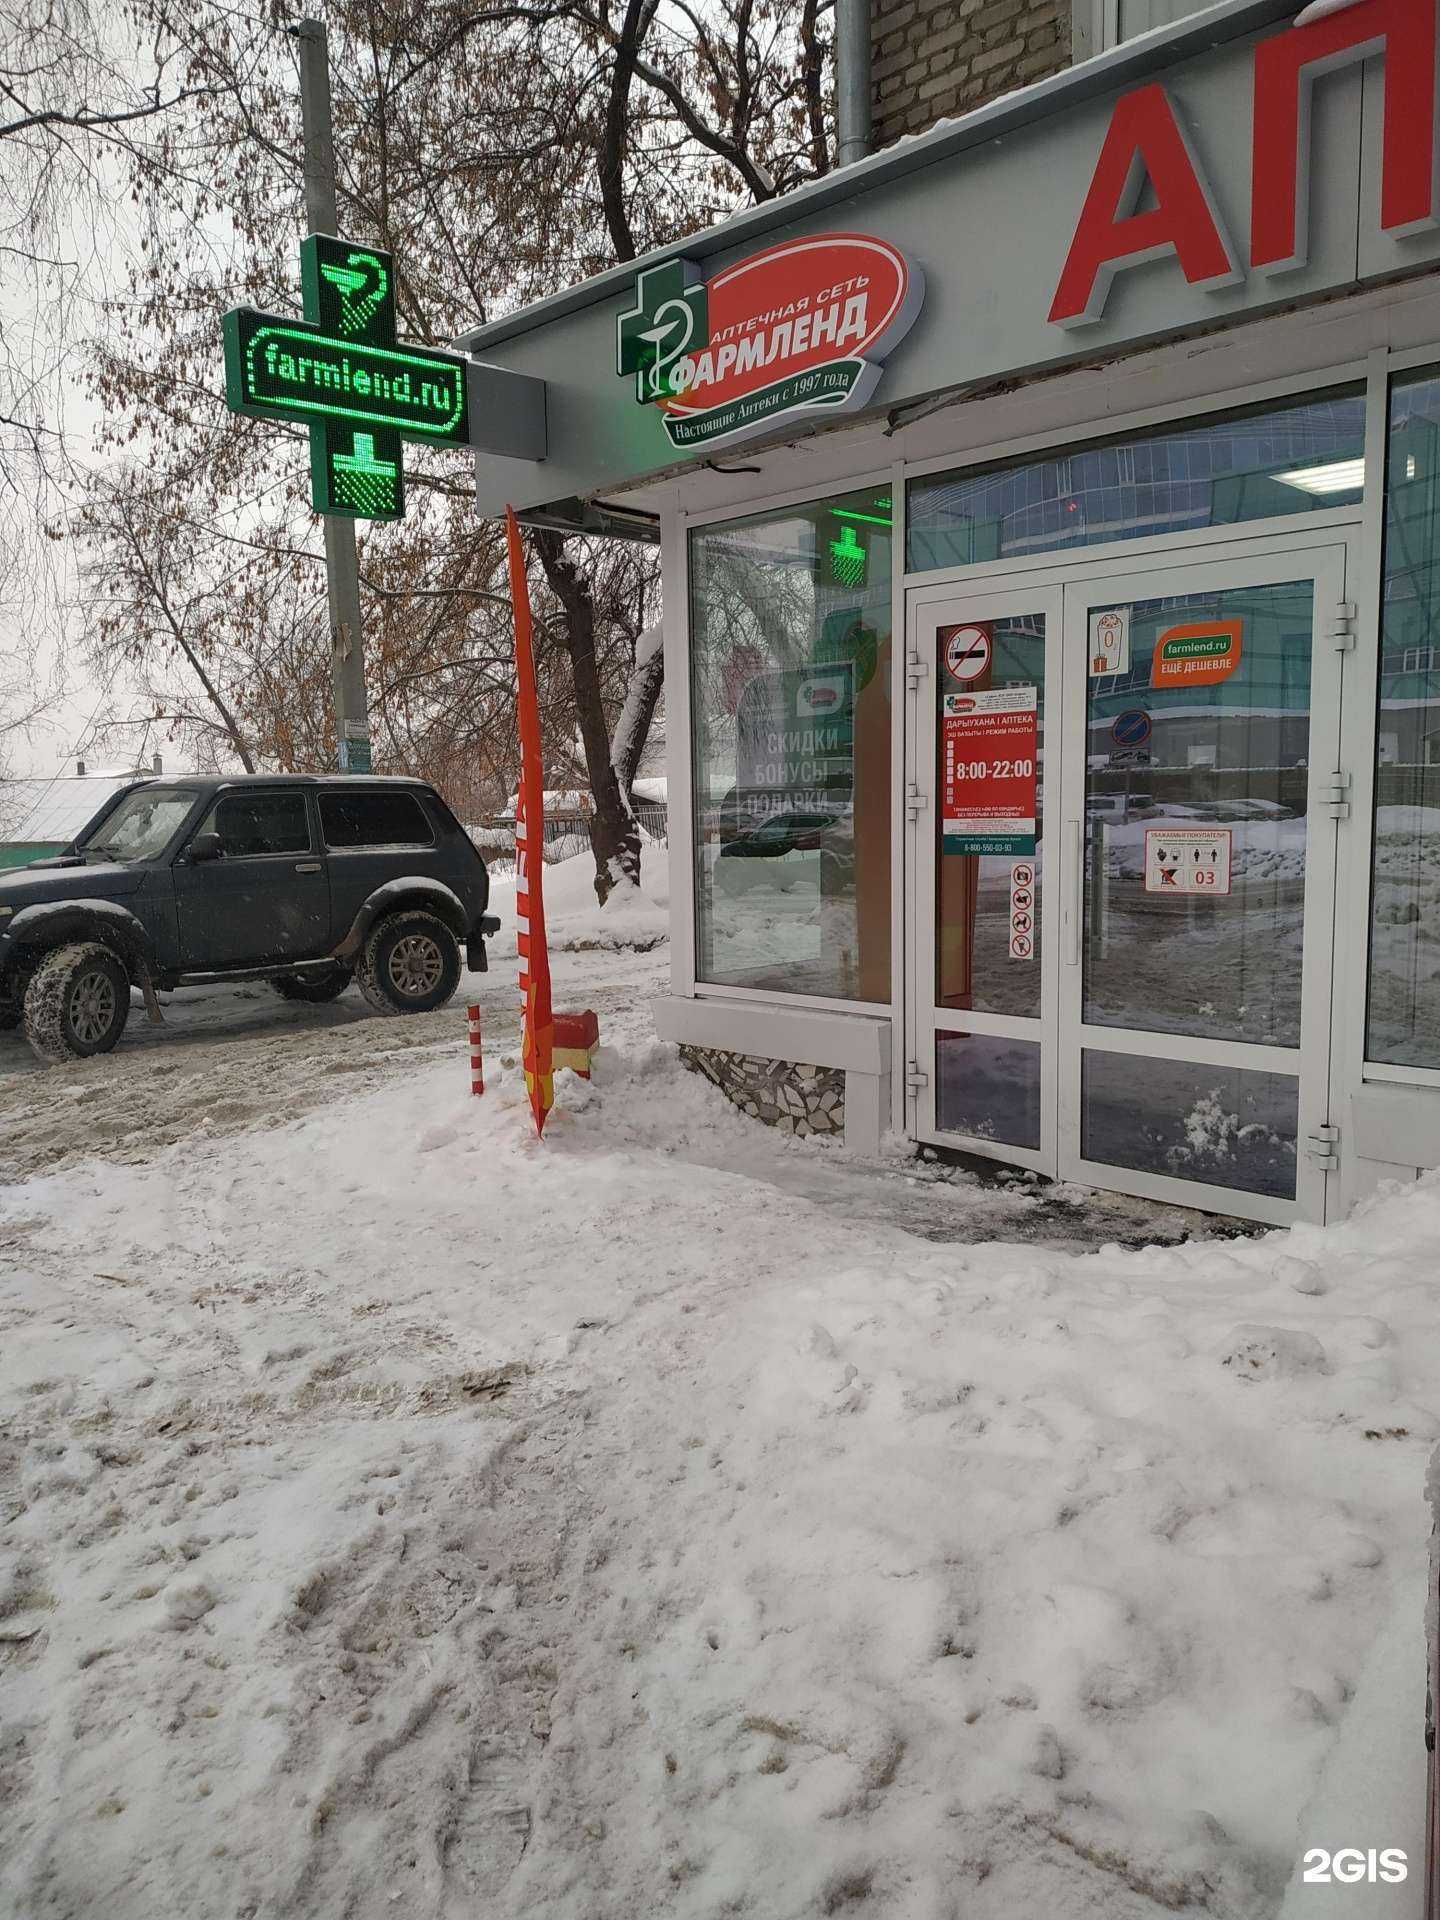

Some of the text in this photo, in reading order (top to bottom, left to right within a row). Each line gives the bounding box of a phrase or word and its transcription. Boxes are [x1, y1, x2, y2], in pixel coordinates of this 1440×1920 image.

[710, 274, 871, 345] АПТЕЧНАЯ СЕТЬ
[668, 291, 869, 396] ФАРМЛЕНД
[265, 343, 450, 410] farmlend.ru
[675, 372, 849, 439] Настоящие Аптеки с 1997 года
[1168, 641, 1227, 654] farmlend.ru
[1161, 659, 1232, 674] ЕЩЁ ДЕШЕВЛЕ
[1001, 714, 1033, 724] АПТЕКА
[1007, 726, 1033, 734] РАБОТЫ
[767, 727, 838, 756] СКИДКИ
[755, 761, 828, 785] БОНУСЫ
[957, 760, 1033, 780] 8:00-22:00
[1195, 871, 1215, 884] 03
